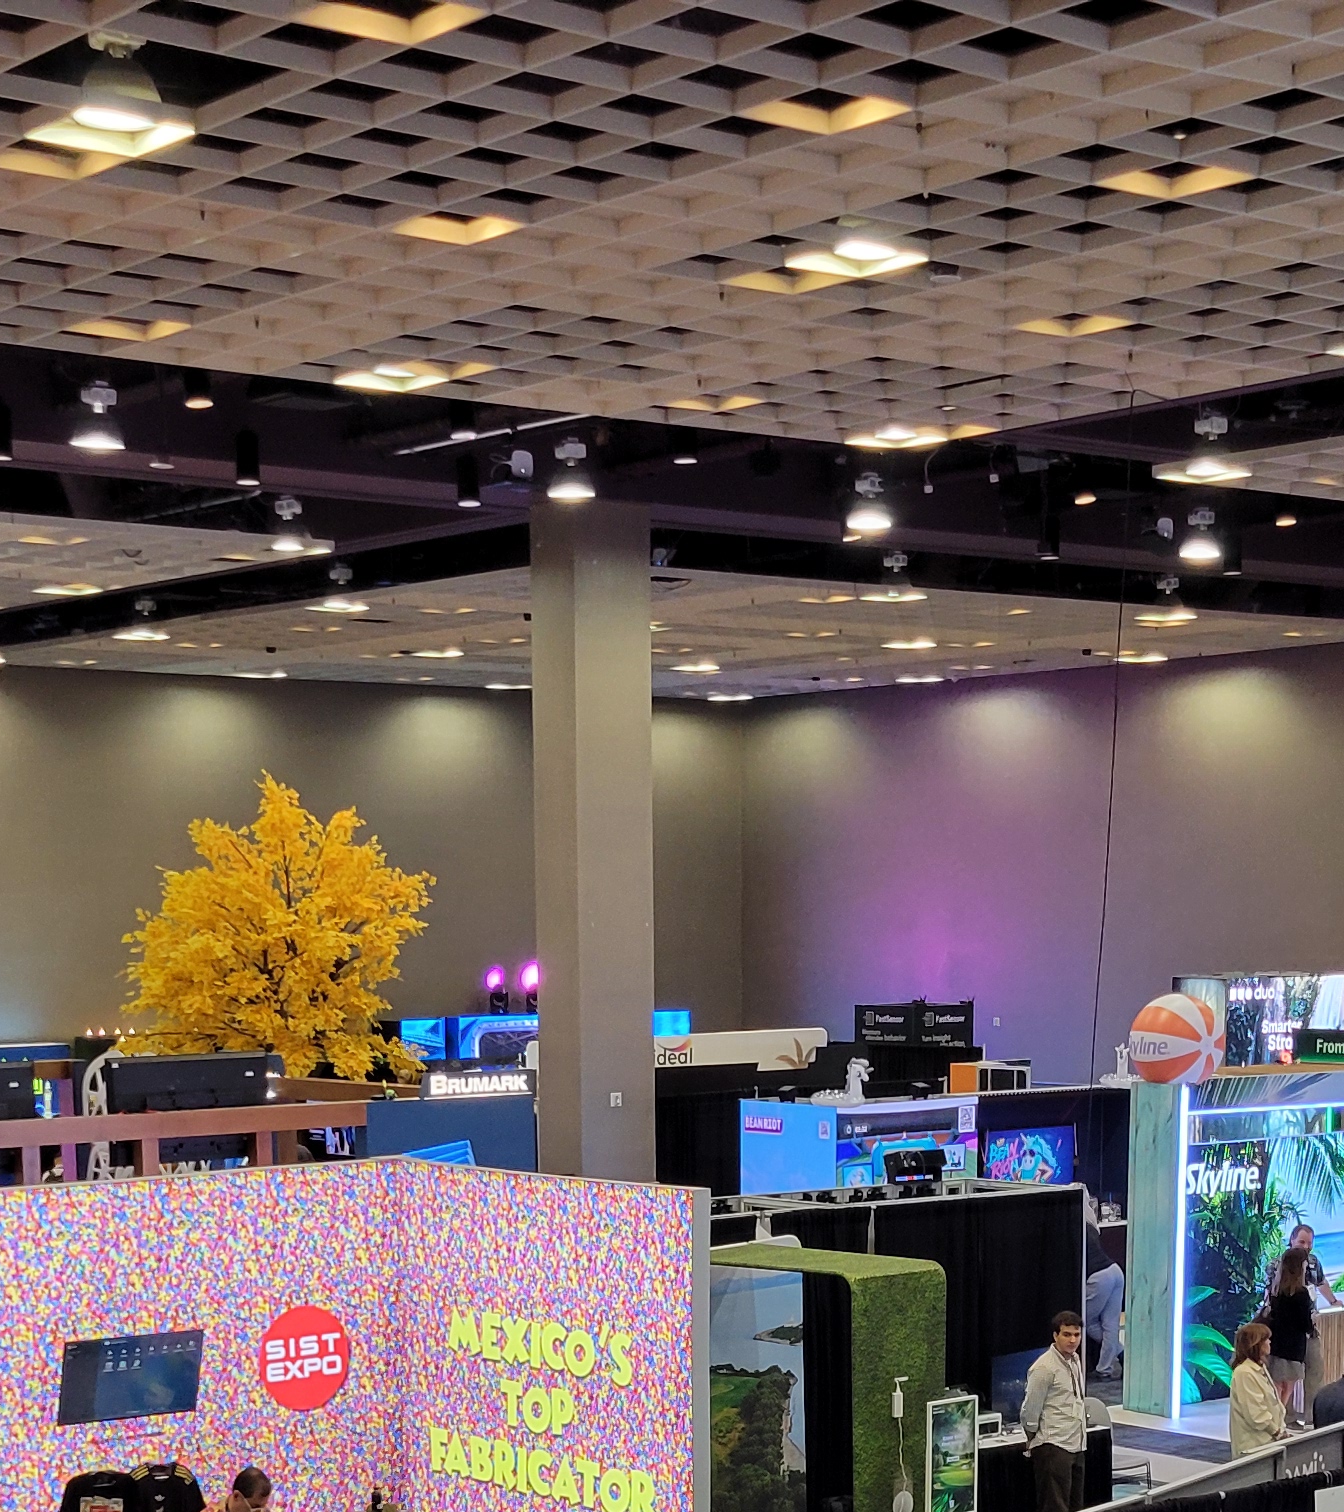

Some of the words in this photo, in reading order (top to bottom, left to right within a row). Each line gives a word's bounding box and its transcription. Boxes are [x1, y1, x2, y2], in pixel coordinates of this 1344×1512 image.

[1254, 987, 1275, 1000] duo
[1262, 1020, 1303, 1033] Smarter
[654, 1049, 693, 1065] deal
[1316, 1038, 1344, 1054] From
[429, 1074, 528, 1096] BRUMARK
[265, 1332, 341, 1361] SIST
[449, 1309, 633, 1387] MEXICO'S
[265, 1356, 342, 1383] EXPO
[500, 1379, 574, 1436] TOP
